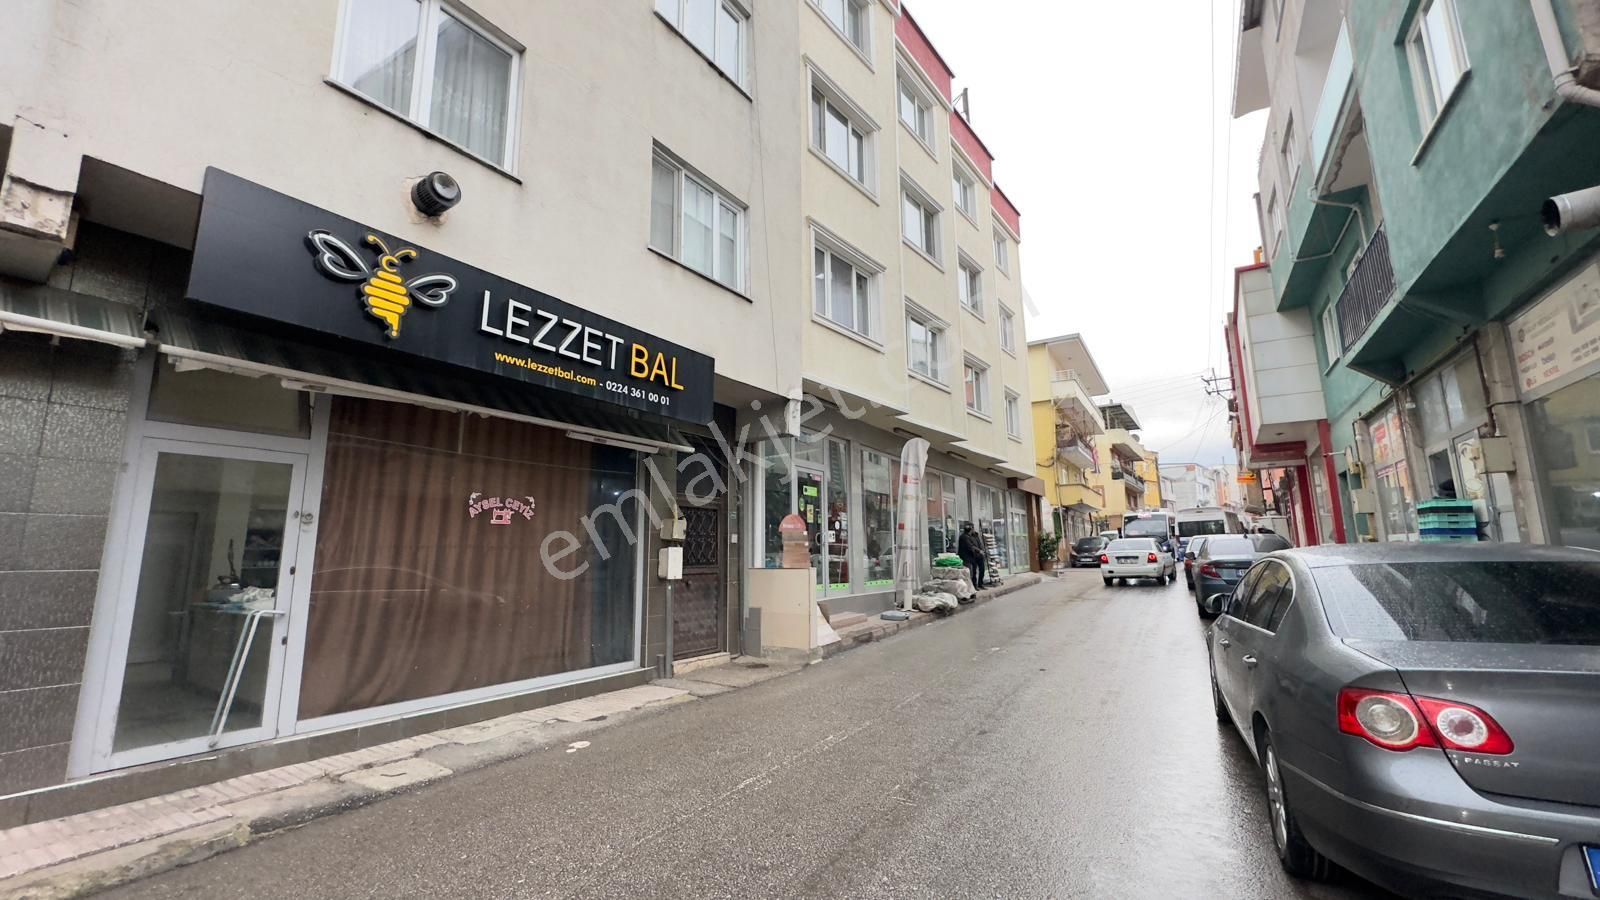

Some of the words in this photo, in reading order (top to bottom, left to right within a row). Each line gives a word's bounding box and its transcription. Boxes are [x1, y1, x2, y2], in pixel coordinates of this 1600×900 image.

[481, 290, 624, 370] LEZZET
[630, 343, 684, 391] BAL
[494, 351, 597, 387] www.lezzetbal.com
[605, 380, 628, 396] 0224
[630, 387, 646, 400] 361
[648, 392, 659, 403] 00
[660, 395, 670, 406] 01
[469, 497, 503, 518] AYSEL
[1464, 757, 1520, 767] PASSAT
